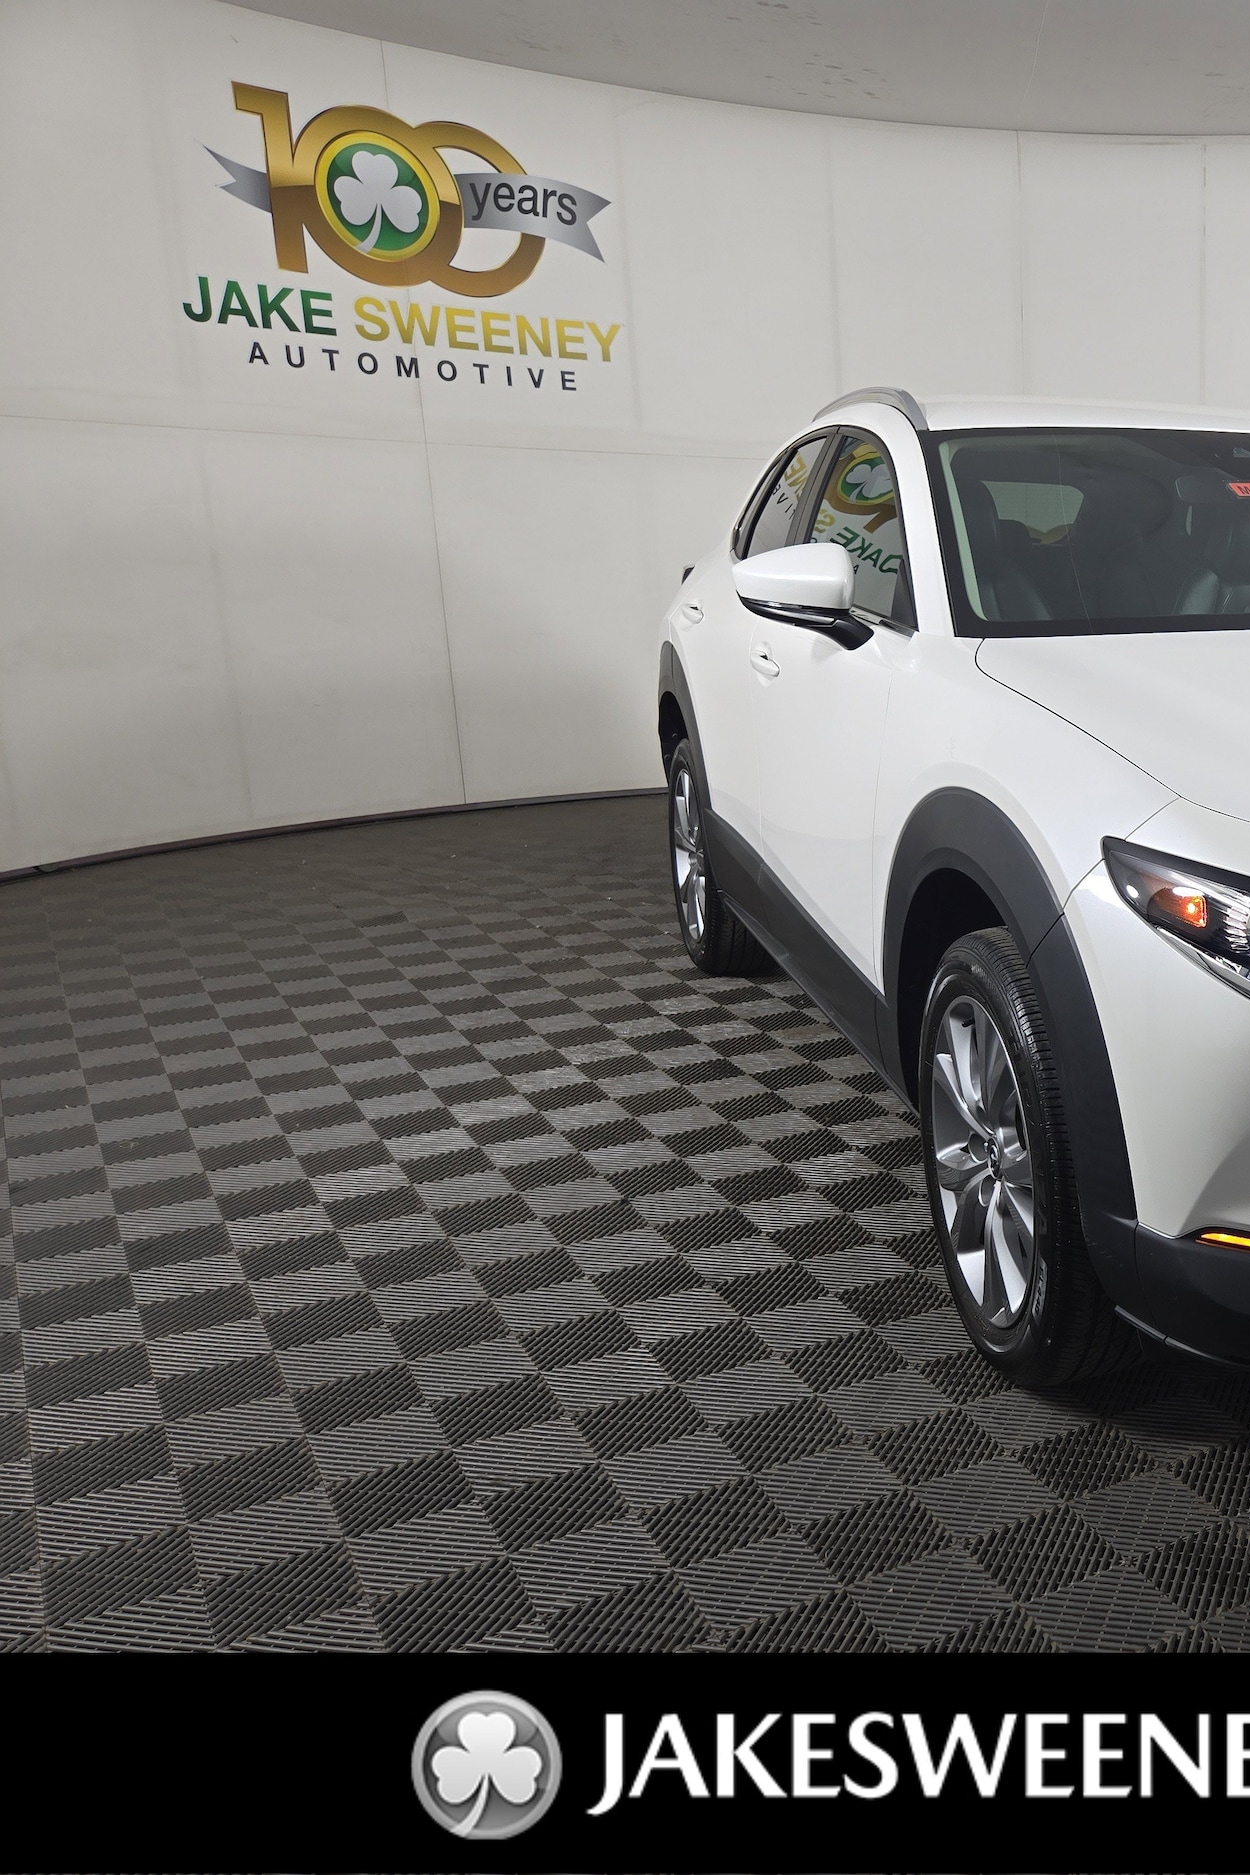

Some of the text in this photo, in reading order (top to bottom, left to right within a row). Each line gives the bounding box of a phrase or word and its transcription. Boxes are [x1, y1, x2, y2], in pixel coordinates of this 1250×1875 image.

[231, 80, 578, 298] 100 years
[183, 276, 621, 362] JAKE SWEENEY
[249, 341, 577, 392] AUTOMOTIVE
